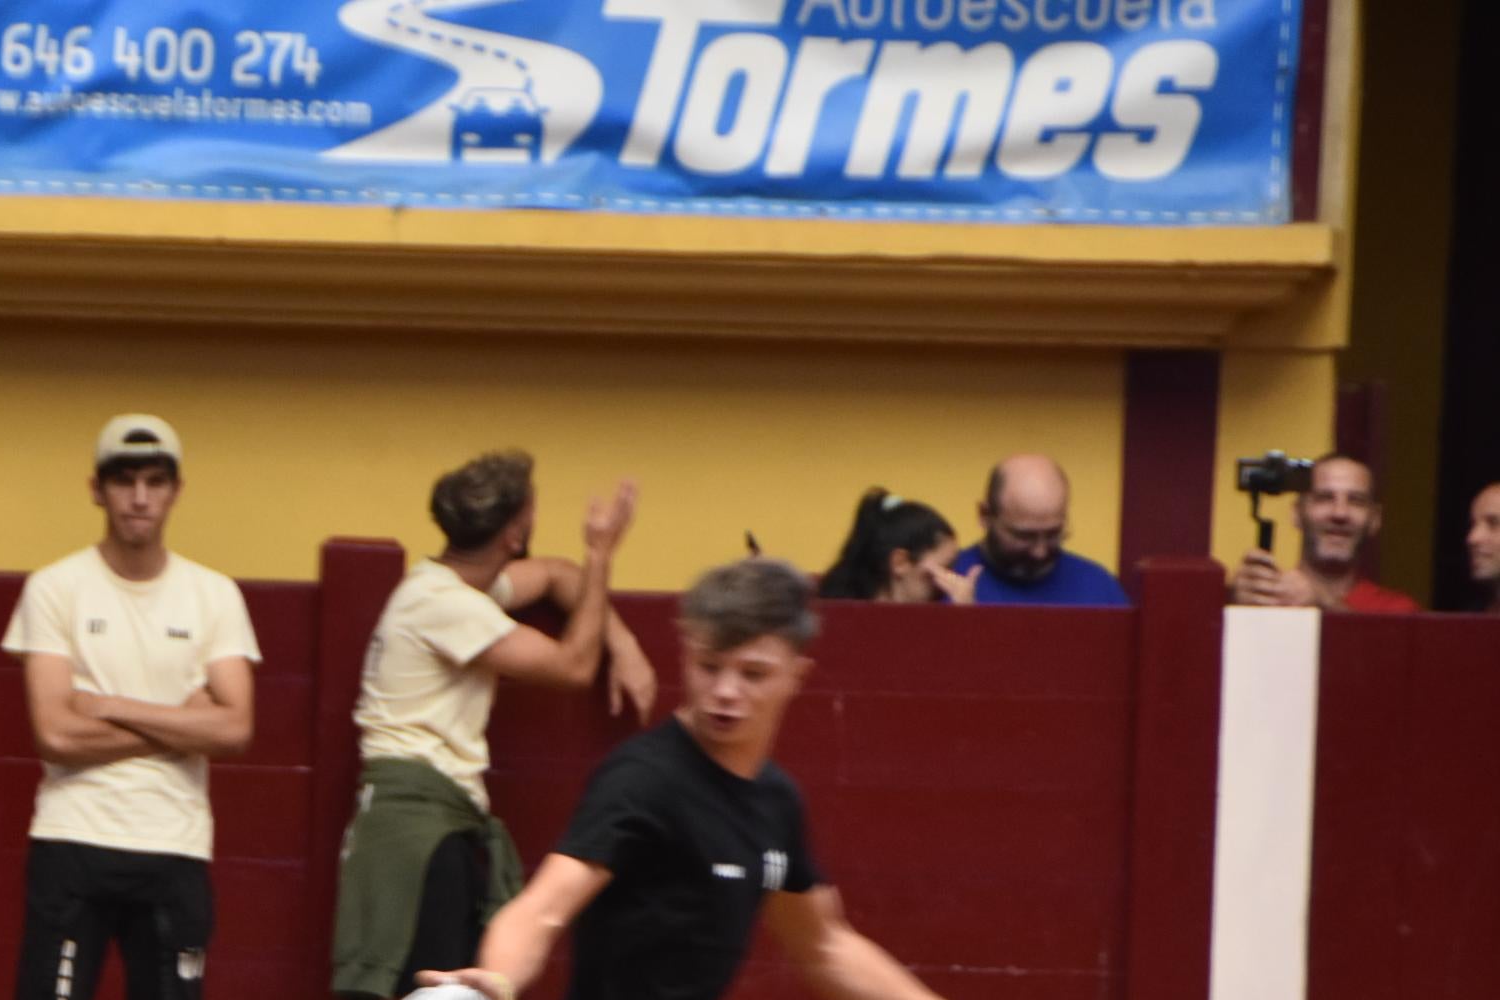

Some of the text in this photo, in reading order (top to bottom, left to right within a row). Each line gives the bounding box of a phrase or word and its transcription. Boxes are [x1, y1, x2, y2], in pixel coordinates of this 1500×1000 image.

[2, 23, 322, 88] 646 400 274
[603, 0, 1219, 179] Tormes
